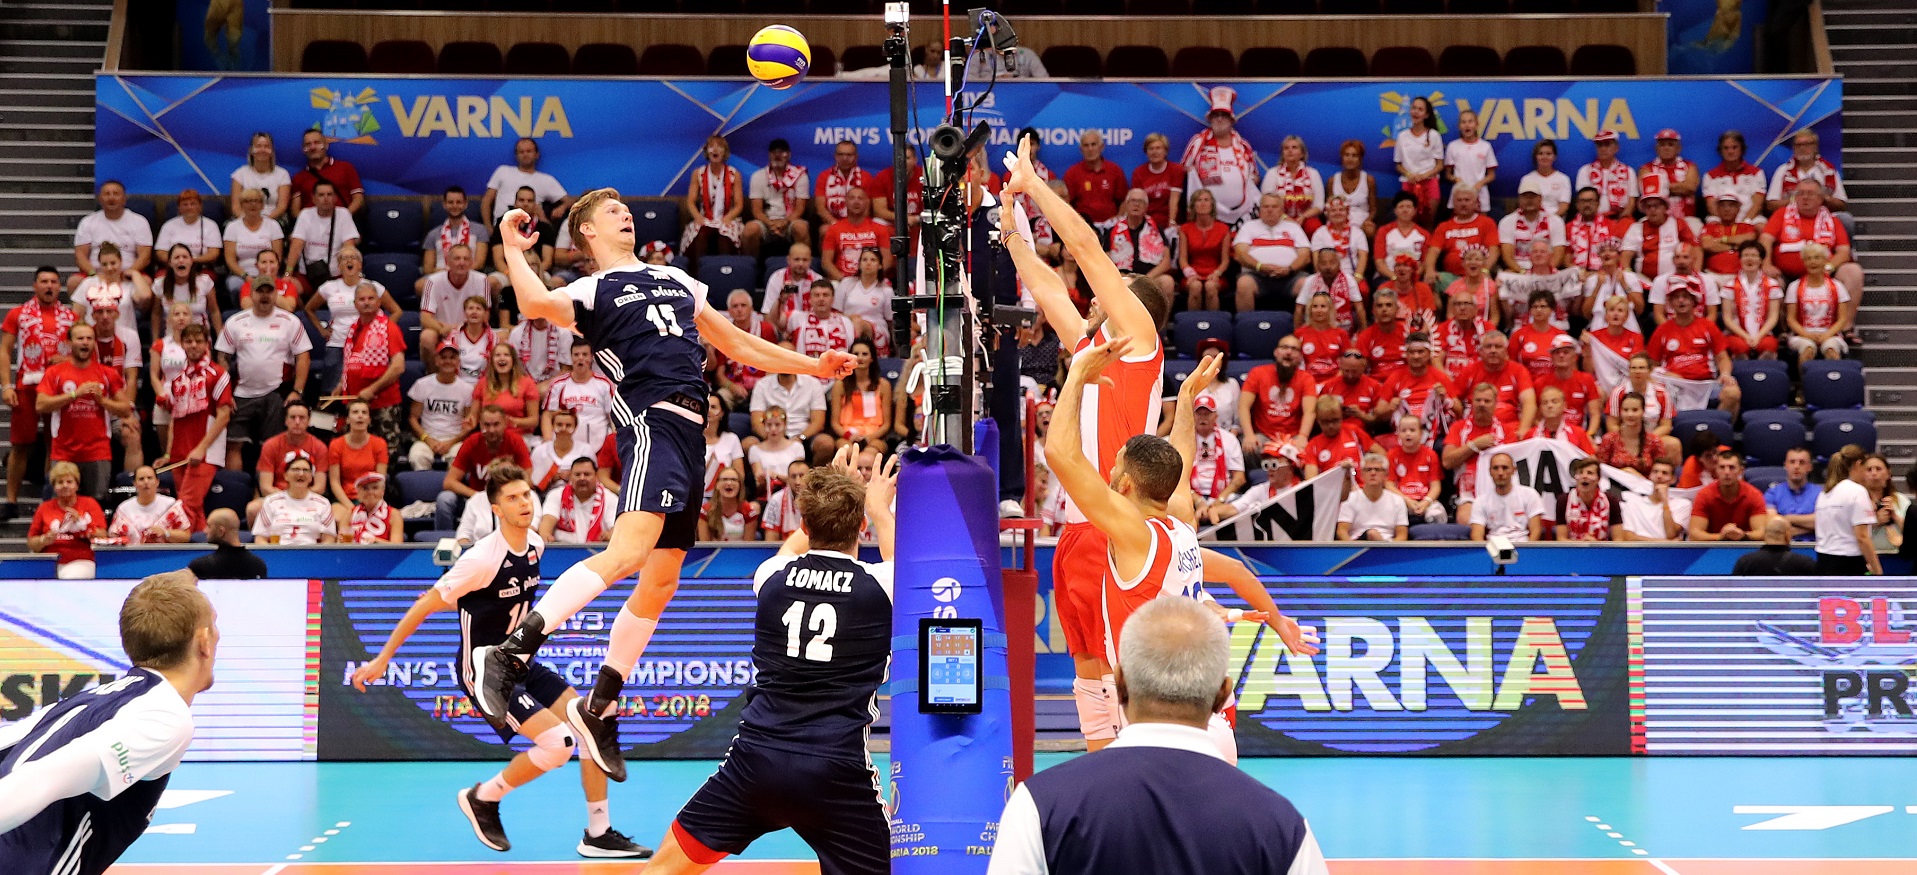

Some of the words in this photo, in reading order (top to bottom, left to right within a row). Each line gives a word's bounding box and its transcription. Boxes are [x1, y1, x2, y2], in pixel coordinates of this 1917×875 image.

[388, 96, 574, 138] VARNA
[814, 127, 880, 145] MEN'S
[646, 304, 683, 337] 15
[427, 399, 459, 414] VANS
[661, 489, 673, 507] 15
[785, 566, 854, 593] ŁOMACZ
[781, 600, 837, 662] 12
[1819, 598, 1912, 644] BL
[653, 694, 712, 717] 2018
[1823, 672, 1914, 716] PR
[111, 741, 132, 774] plus
[912, 846, 939, 856] 2018
